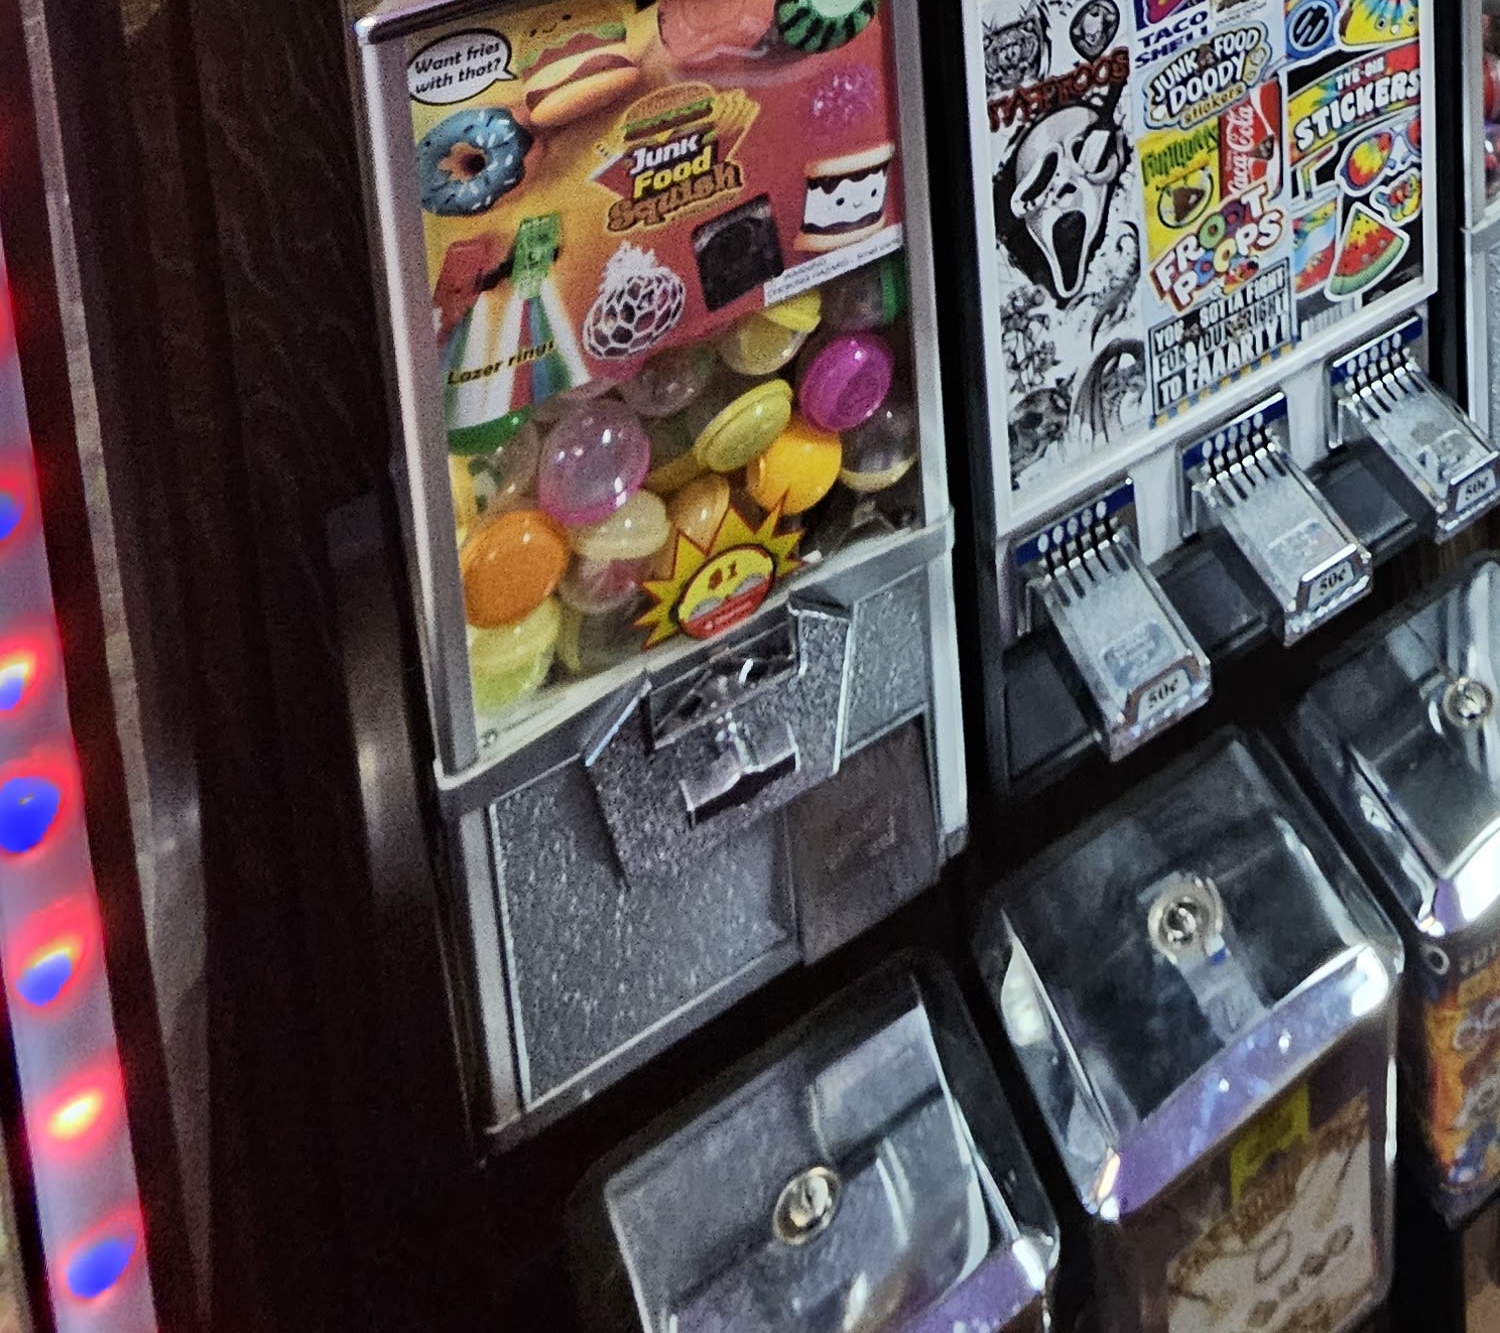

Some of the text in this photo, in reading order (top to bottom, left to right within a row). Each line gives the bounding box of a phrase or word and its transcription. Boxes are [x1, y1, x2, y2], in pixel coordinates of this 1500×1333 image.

[1138, 10, 1209, 49] TACO
[415, 42, 501, 75] Want fries
[415, 57, 502, 94] with that?
[1152, 28, 1260, 103] JUNK FOOD
[1168, 50, 1246, 116] DOODY
[1294, 68, 1421, 151] STICKERS
[630, 133, 700, 176] Junk
[633, 145, 712, 200] Food
[607, 161, 743, 232] Squish
[1153, 183, 1268, 296] FROOT
[1171, 209, 1284, 309] POOPS
[447, 361, 503, 385] Lazer
[1160, 375, 1183, 406] TO
